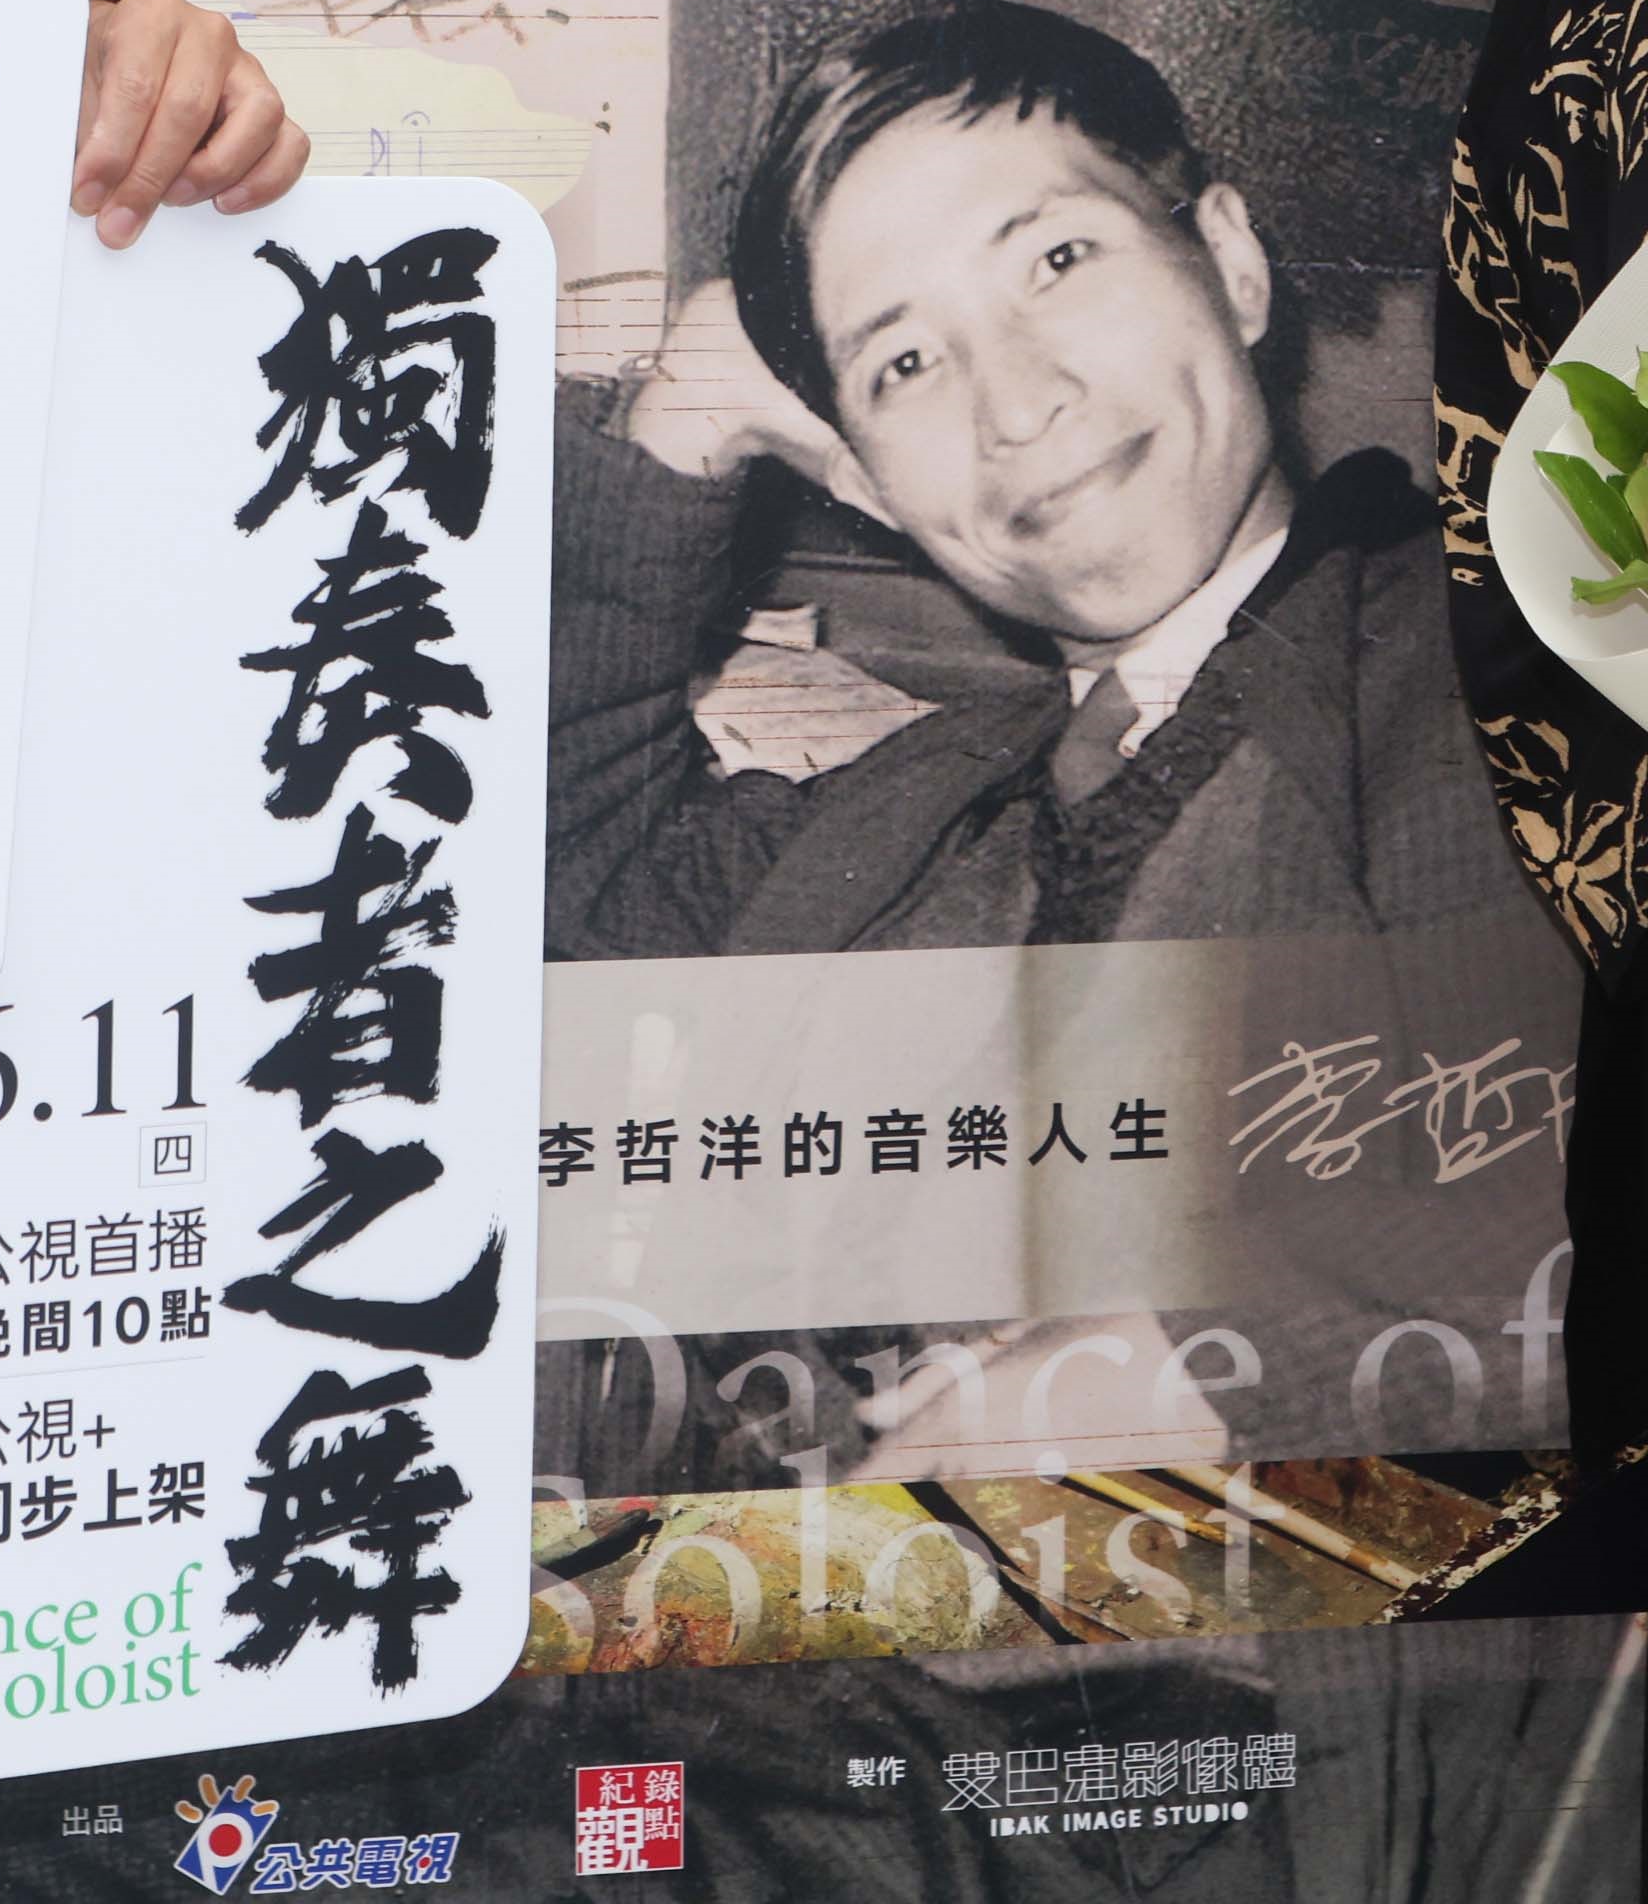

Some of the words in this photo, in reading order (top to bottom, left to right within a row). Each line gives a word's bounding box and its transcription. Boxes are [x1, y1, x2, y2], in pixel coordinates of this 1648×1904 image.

[218, 226, 509, 1701] 獨奏者之舞
[154, 1134, 192, 1175] 四
[538, 1098, 1169, 1187] 李哲洋的音樂人生
[124, 1561, 202, 1638] of
[599, 1770, 681, 1805] 紀錄
[846, 1756, 907, 1788] 製作
[62, 1805, 123, 1838] 出品
[576, 1807, 681, 1874] 觀點
[990, 1814, 1050, 1838] IBAK
[1063, 1808, 1141, 1832] IMAGE
[1153, 1801, 1249, 1827] STUDIO
[251, 1832, 460, 1894] 公共電視
